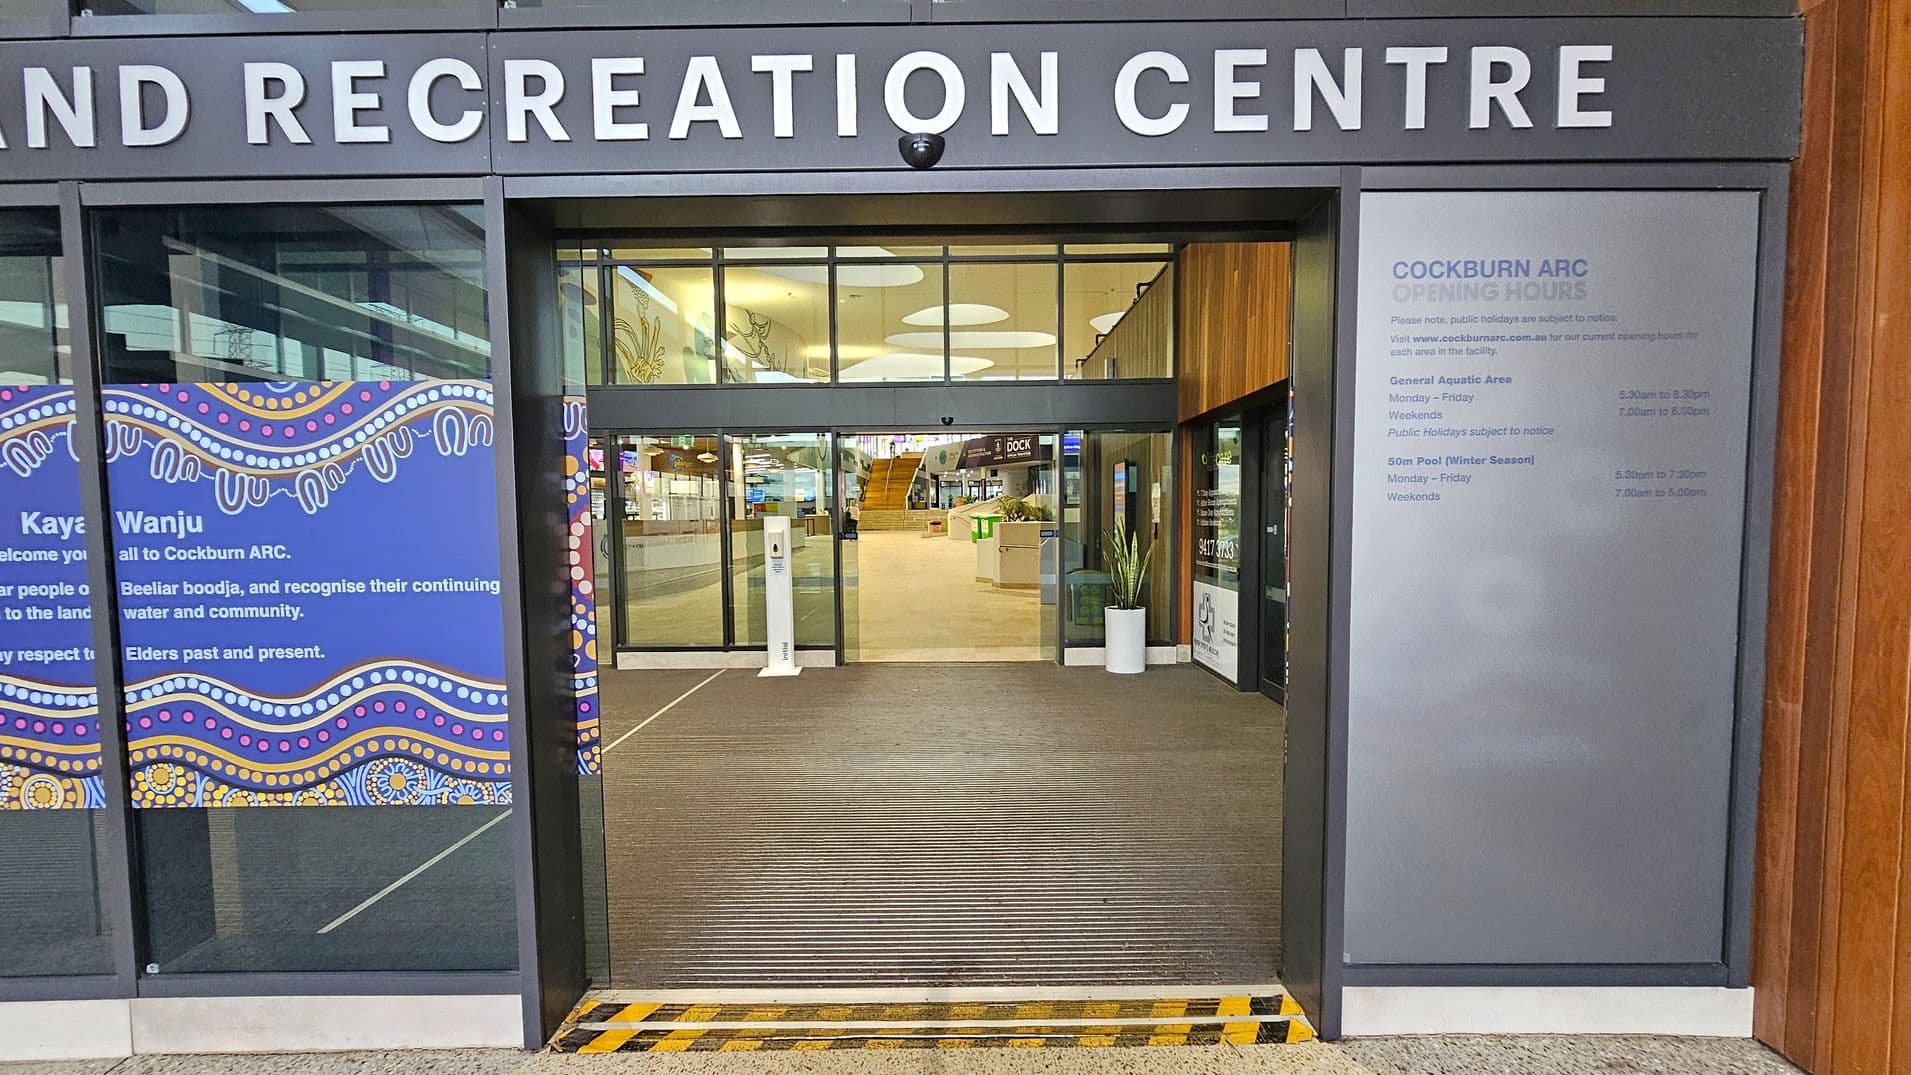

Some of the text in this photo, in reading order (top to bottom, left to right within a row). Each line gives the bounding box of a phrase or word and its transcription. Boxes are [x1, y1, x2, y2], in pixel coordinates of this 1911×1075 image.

[0, 45, 1613, 148] ND RECREATION CENTRE
[1392, 258, 1588, 280] COCKBURN ARC
[1392, 280, 1587, 302] OPENING HOURS
[1391, 315, 1422, 325] Please
[1425, 316, 1448, 325] note,
[1450, 314, 1478, 326] public
[1481, 314, 1518, 326] holidays
[1539, 314, 1573, 324] subject
[1576, 314, 1585, 322] to
[1390, 335, 1410, 343] Visit
[1412, 334, 1546, 343] www.cockburnarc.com.au
[1550, 333, 1563, 341] for
[1582, 332, 1616, 341] current
[1618, 332, 1656, 342] opening
[1658, 332, 1683, 340] hours
[1390, 346, 1498, 357] each area in the facility.
[1390, 375, 1512, 386] General Aquatic Area
[1389, 393, 1430, 404] Monday
[1442, 392, 1474, 404] Friday
[1660, 390, 1670, 399] to
[1389, 410, 1443, 420] Weekends
[1659, 408, 1668, 416] to
[1388, 427, 1554, 438] Public Holidays subject to notice
[1006, 438, 1031, 452] DOCK
[1388, 454, 1535, 466] 50m Pool (Winter Season)
[1388, 474, 1428, 485] Monday
[1440, 473, 1472, 484] Friday
[1657, 470, 1666, 479] to
[1387, 491, 1441, 501] Weekends
[1655, 488, 1665, 497] to
[21, 510, 203, 540] Kaya Wanju
[119, 547, 138, 561] all
[142, 547, 160, 560] to
[164, 546, 245, 560] Cockburn
[249, 545, 291, 559] ARC.
[1199, 538, 1215, 556] 9417
[18, 582, 74, 599] people
[120, 581, 179, 596] Beeliar
[183, 580, 245, 598] boodja,
[249, 580, 279, 594] and
[284, 579, 365, 596] recognise
[370, 578, 408, 593] their
[412, 578, 500, 595] continuing
[4, 603, 304, 621] to the land water and community.
[18, 647, 80, 664] respect
[126, 647, 179, 661] Elders
[183, 646, 219, 663] past
[223, 645, 254, 660] and
[258, 645, 325, 662] present.
